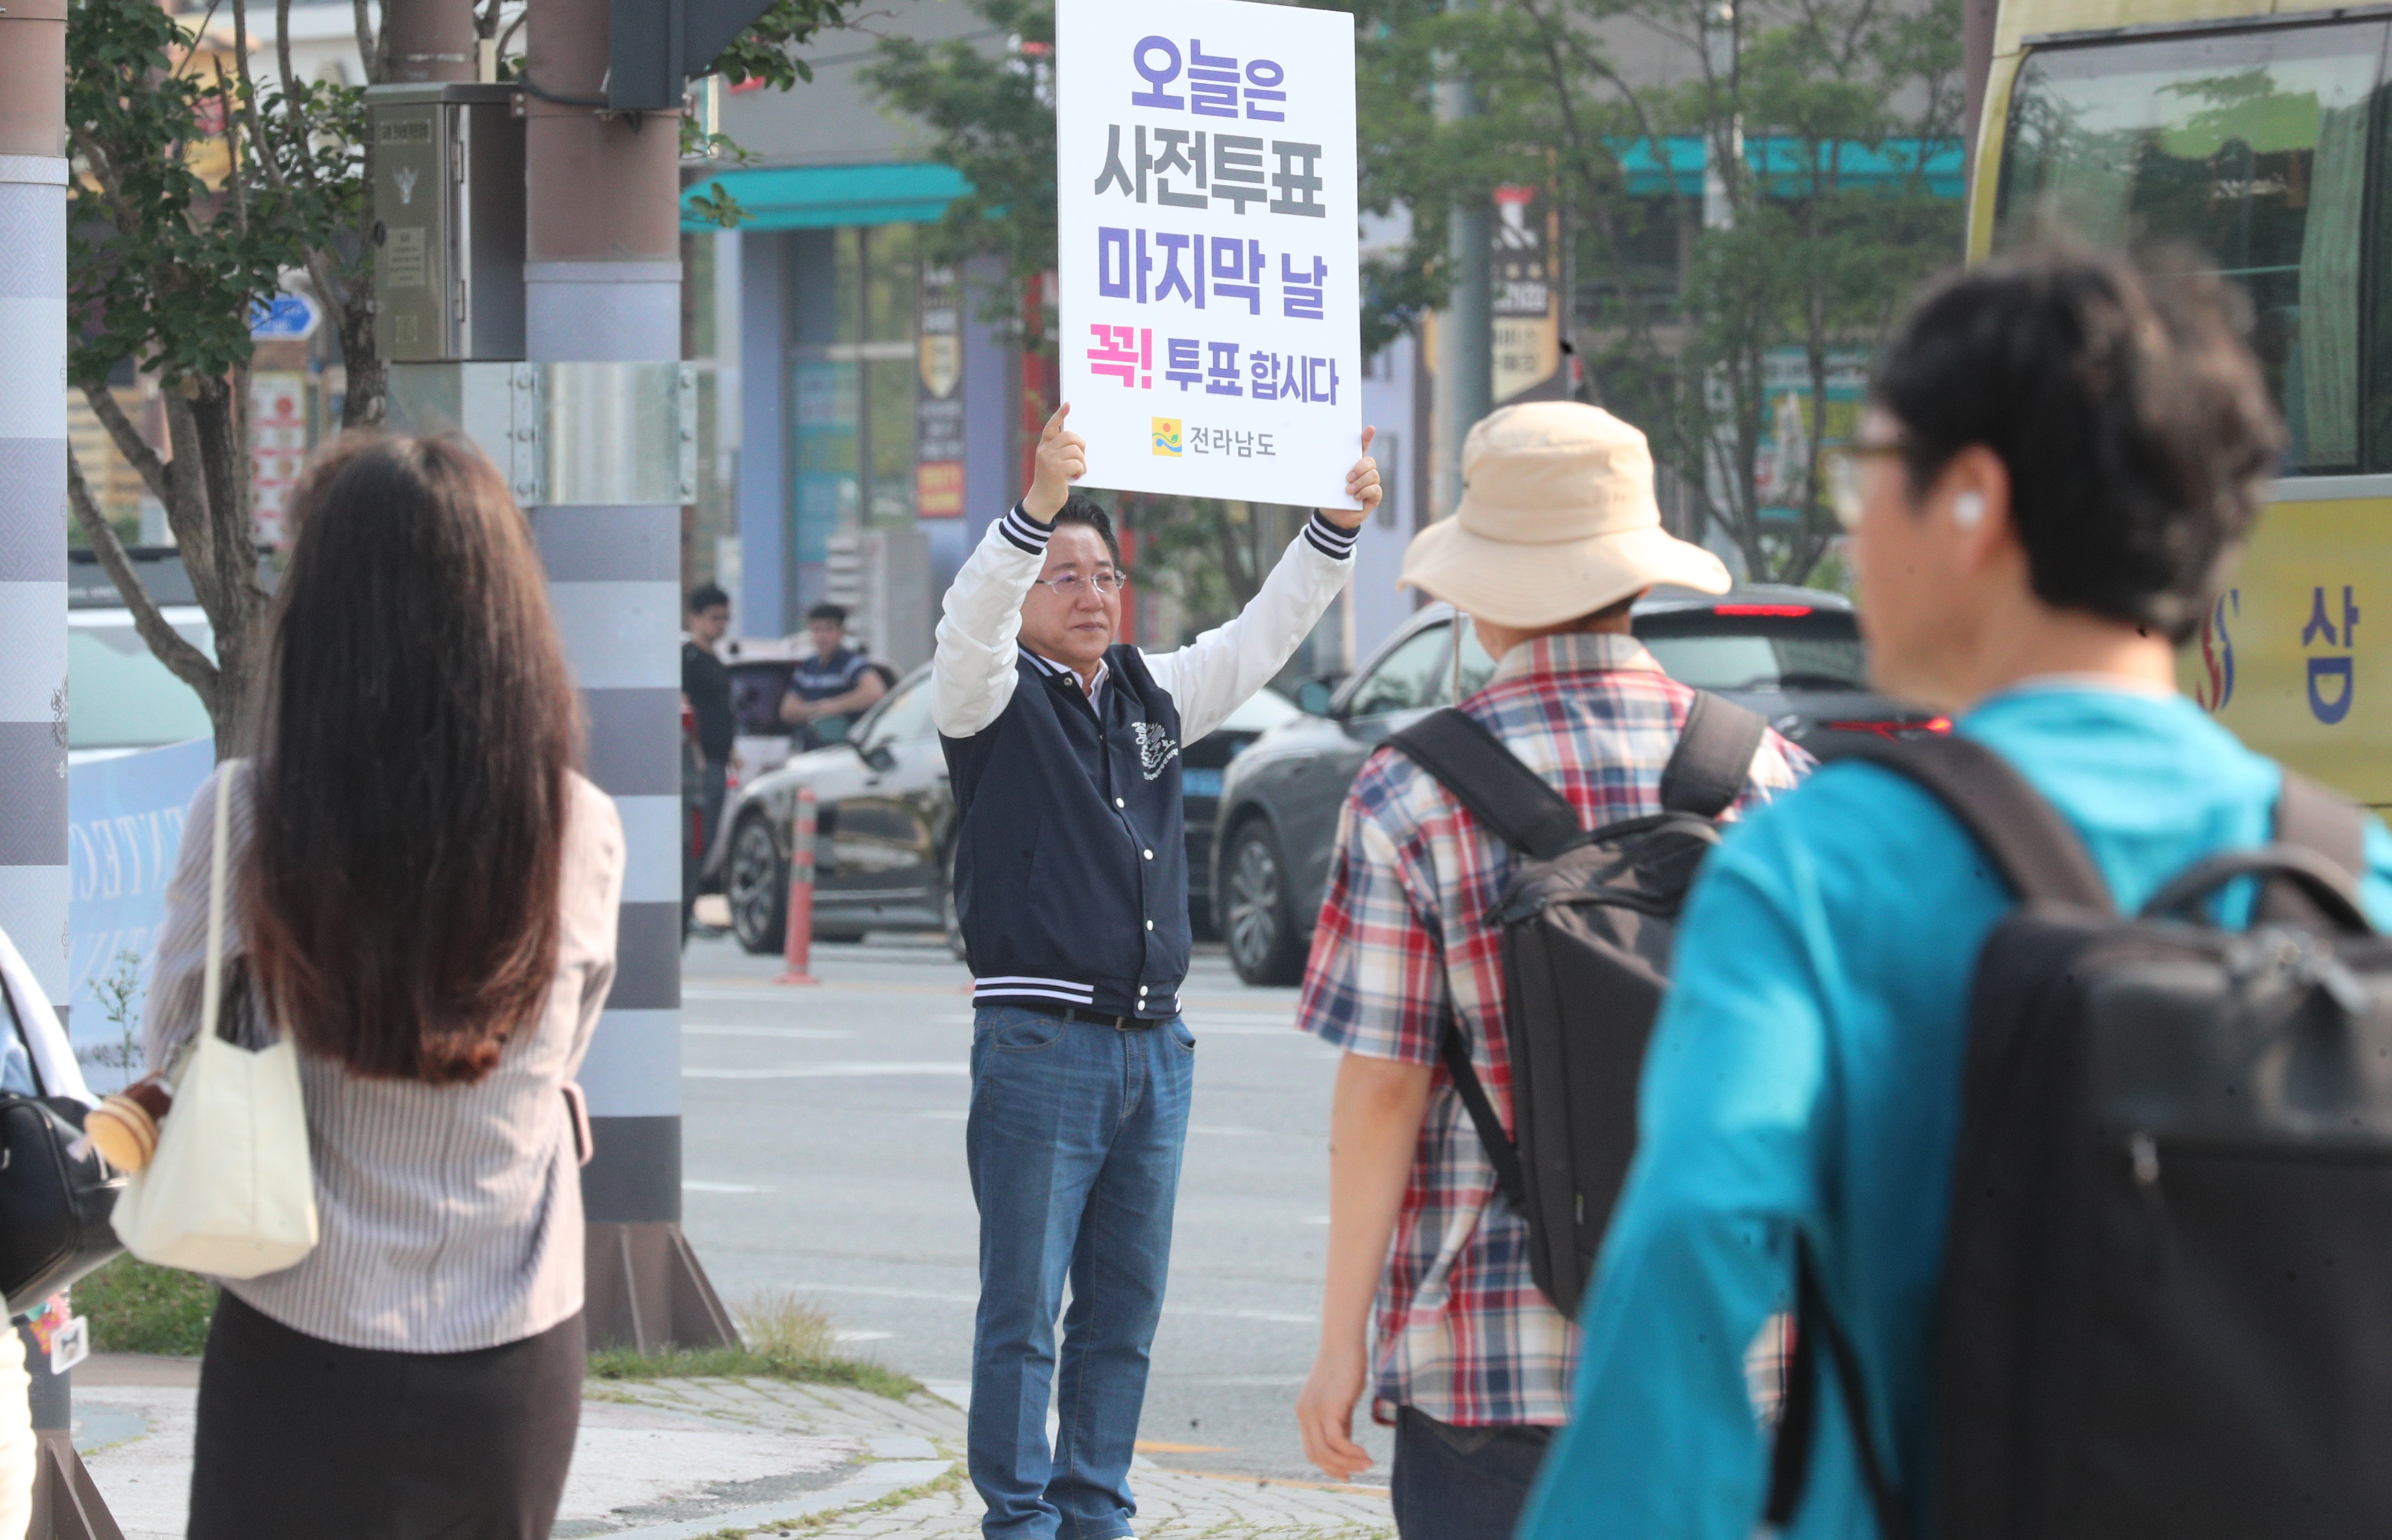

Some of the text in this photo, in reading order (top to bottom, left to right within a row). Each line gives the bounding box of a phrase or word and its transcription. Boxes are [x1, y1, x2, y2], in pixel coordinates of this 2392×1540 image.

[1132, 35, 1286, 122] 오늘은
[1094, 124, 1325, 218] 사전투표
[1098, 227, 1327, 320] 마지막 날
[1087, 324, 1339, 406] 꼭! 투표 합시다
[1190, 427, 1276, 457] 전라남도
